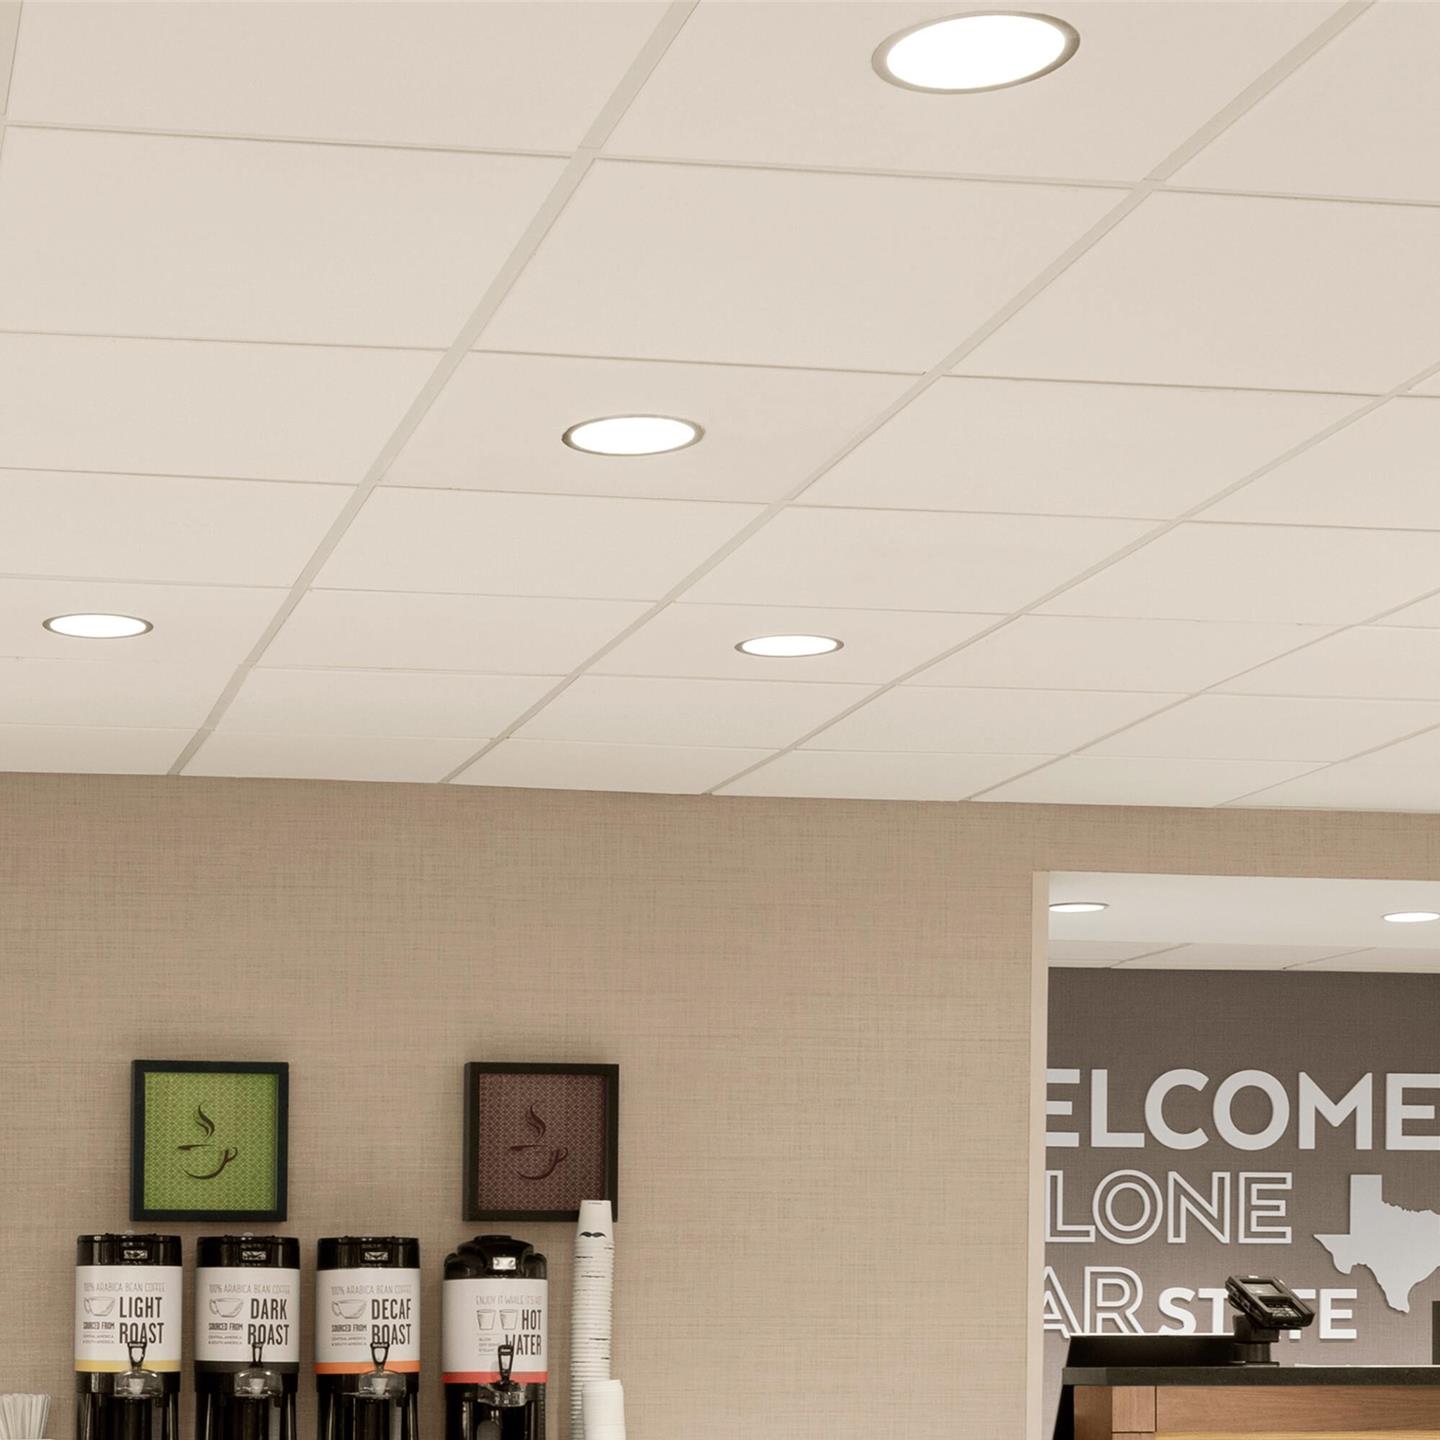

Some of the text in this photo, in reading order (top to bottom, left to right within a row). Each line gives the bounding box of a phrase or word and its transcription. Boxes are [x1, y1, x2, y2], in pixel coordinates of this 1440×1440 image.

[1044, 1168, 1293, 1245] LONE
[118, 1296, 163, 1319] LIGHT
[250, 1297, 288, 1320] DARK
[371, 1298, 412, 1320] DECAF
[1157, 1286, 1358, 1341] STE
[521, 1308, 543, 1331] HOT
[118, 1322, 165, 1345] ROAST
[247, 1323, 290, 1346] ROAST
[371, 1324, 412, 1345] ROAST
[504, 1333, 543, 1356] WATER
